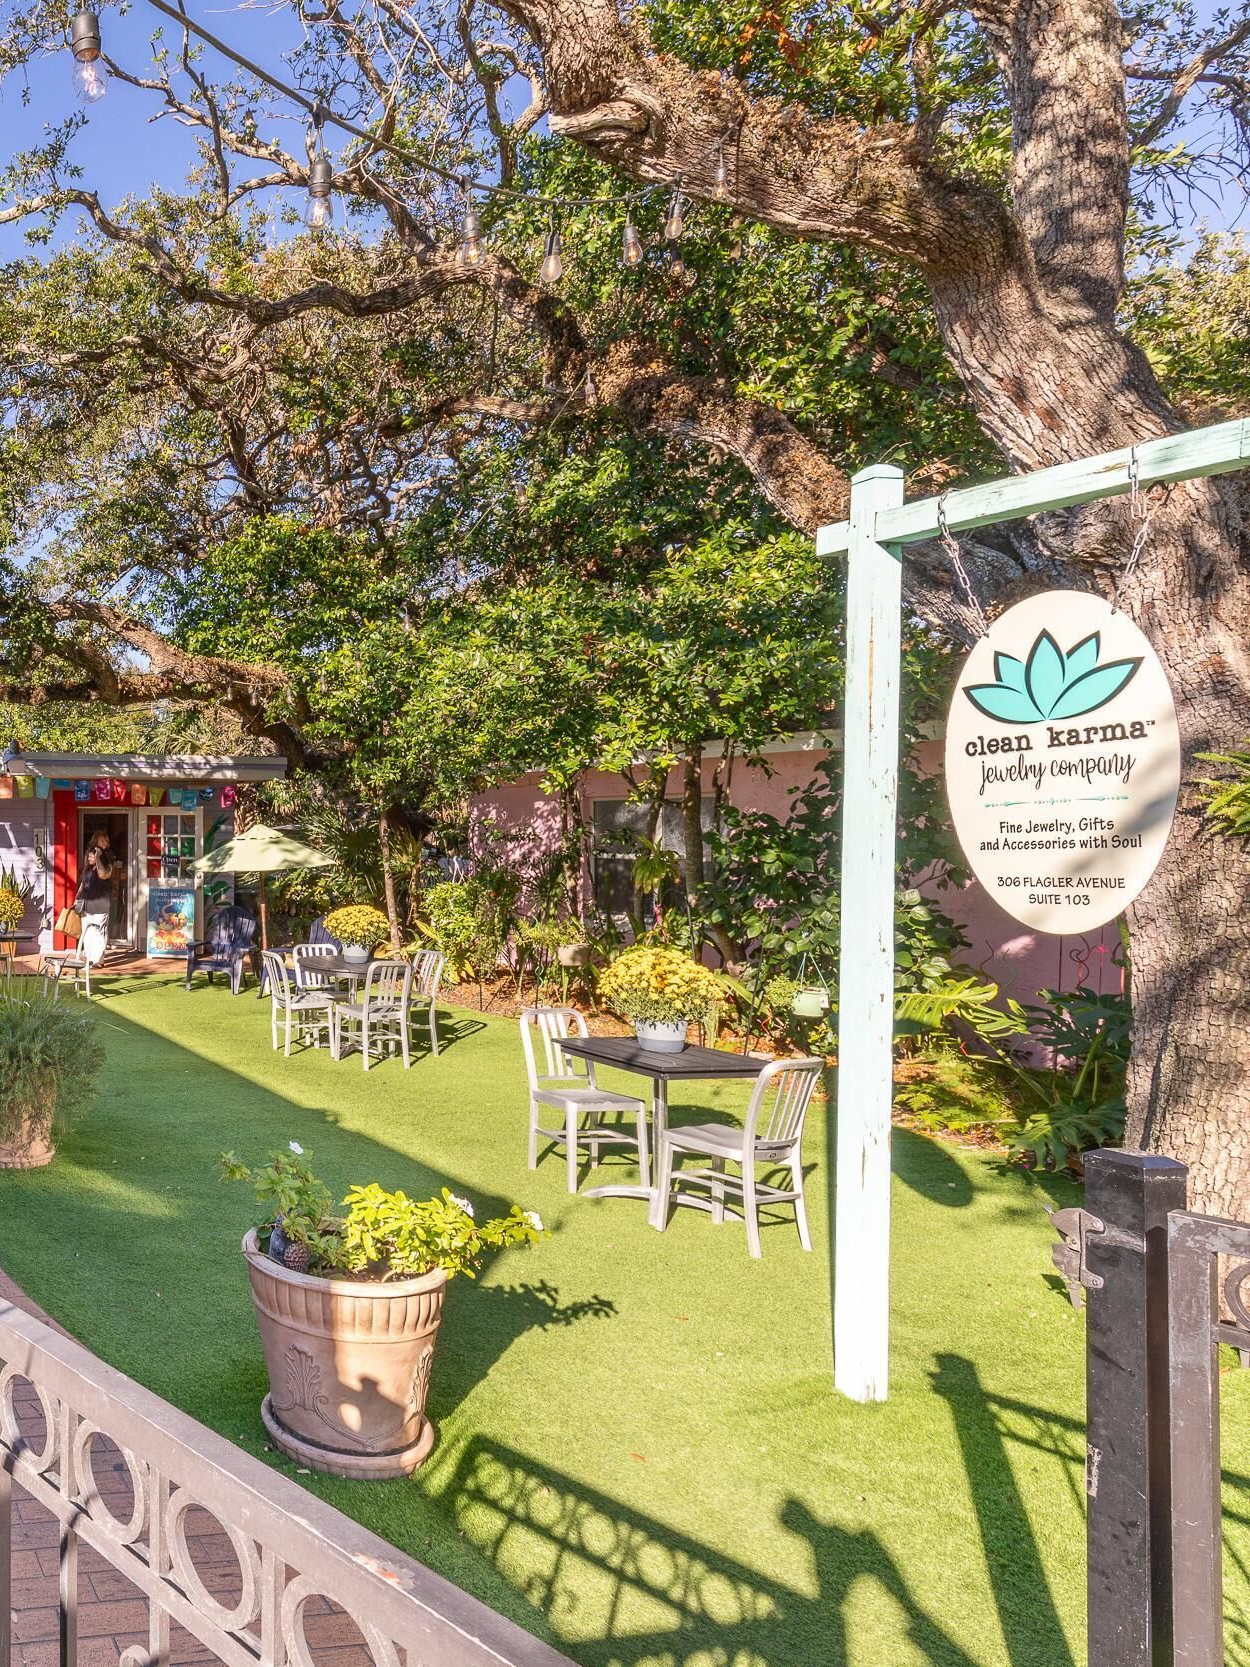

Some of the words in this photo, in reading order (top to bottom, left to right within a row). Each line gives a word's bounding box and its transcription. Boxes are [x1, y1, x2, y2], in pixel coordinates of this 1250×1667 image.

[965, 734, 1033, 757] clean
[979, 753, 1047, 796] jewelry
[1050, 753, 1137, 785] company
[999, 821, 1023, 834] Fine
[1025, 819, 1076, 836] Jewelry,
[1078, 818, 1115, 832] Gifts
[35, 833, 45, 870] 103
[980, 838, 1000, 851] and
[1002, 837, 1076, 851] Accessories
[1078, 836, 1109, 850] with
[1111, 834, 1143, 849] Soul
[997, 876, 1022, 888] 306
[1023, 876, 1076, 889] FLAGLER
[1076, 877, 1126, 889] AVENUE
[1029, 893, 1061, 905] SUITE
[1065, 894, 1091, 906] 103
